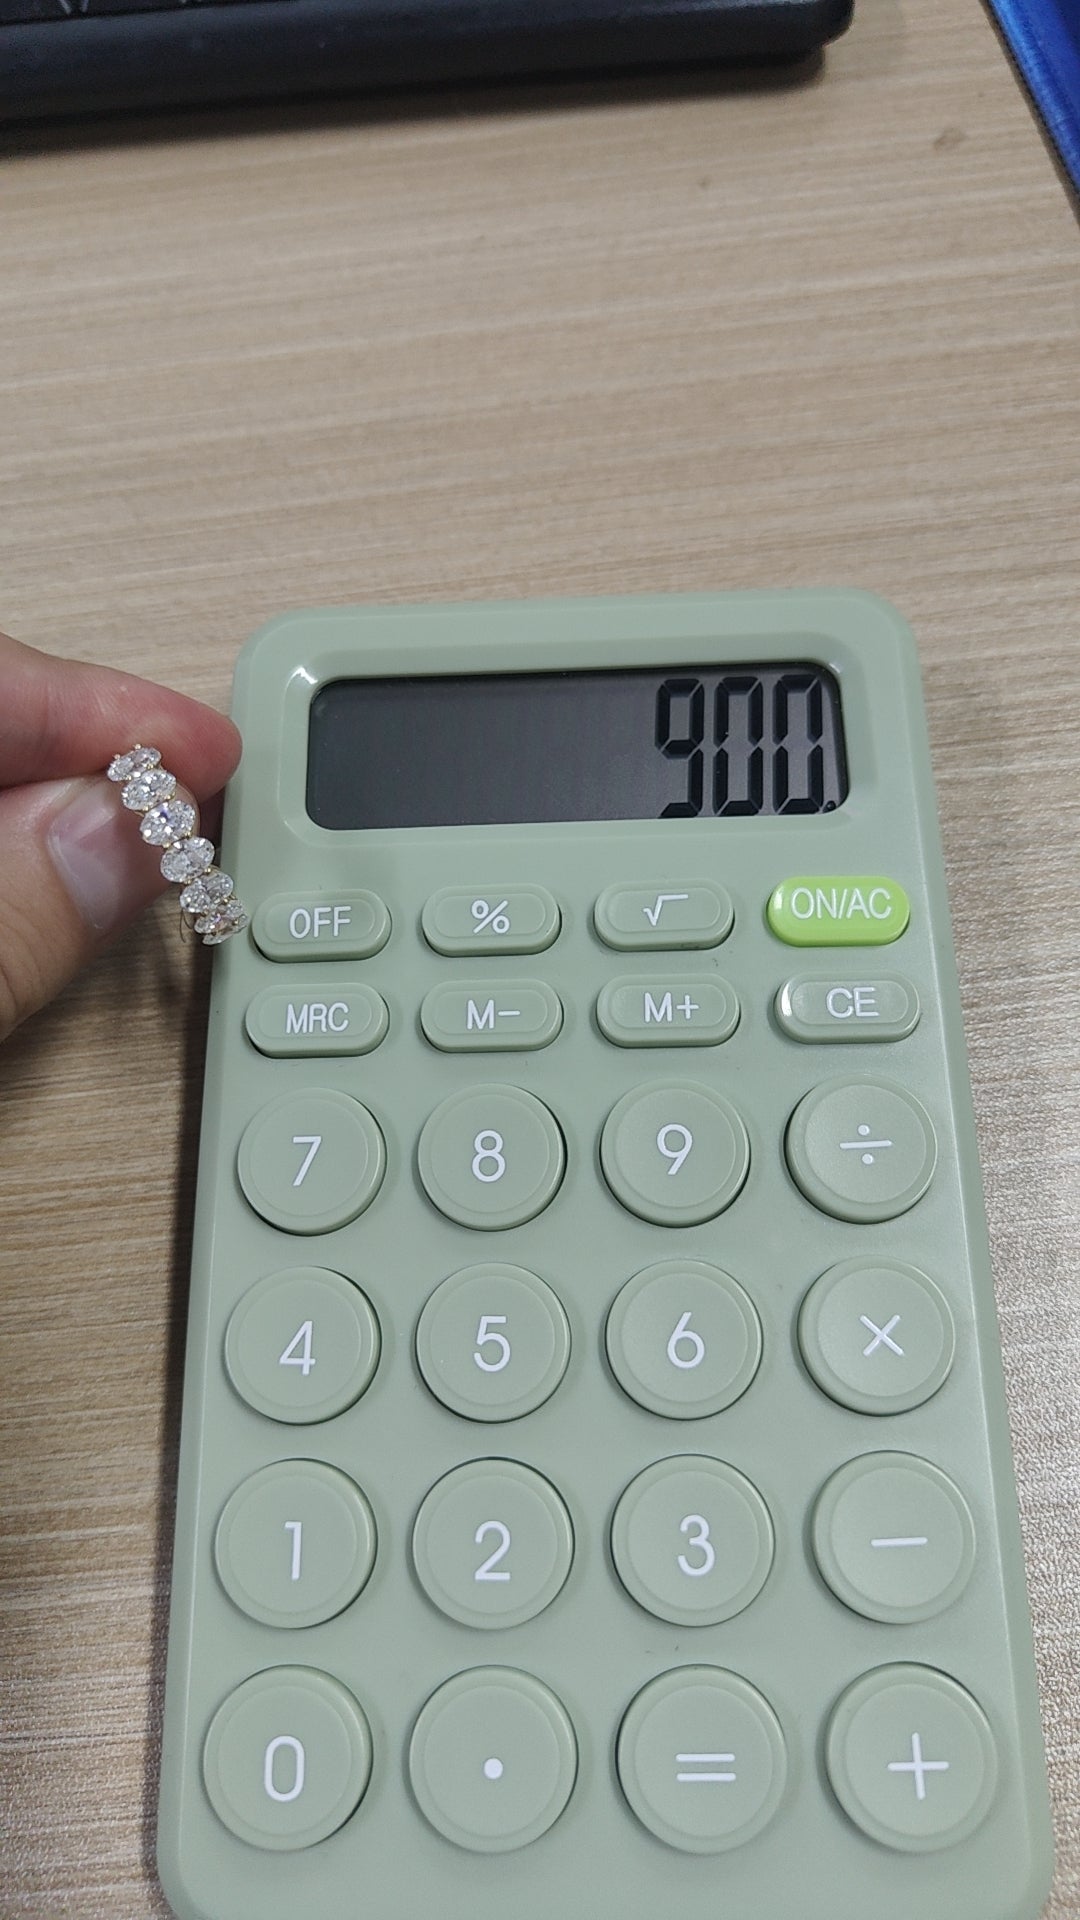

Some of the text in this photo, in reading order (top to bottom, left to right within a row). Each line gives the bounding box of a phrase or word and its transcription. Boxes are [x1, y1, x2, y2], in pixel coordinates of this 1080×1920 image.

[289, 906, 351, 939] OFF
[471, 899, 510, 934] %
[790, 887, 892, 919] ON/AC
[286, 1002, 349, 1034] MRC
[644, 992, 699, 1023] M+
[826, 986, 880, 1018] CE
[292, 1135, 322, 1186] 7
[471, 1130, 506, 1182] 8
[656, 1124, 693, 1175] 9
[279, 1320, 316, 1376] 4
[473, 1315, 511, 1372] 5
[667, 1311, 705, 1369] 6
[284, 1521, 302, 1581] 1
[474, 1520, 511, 1581] 2
[677, 1514, 715, 1577] 3
[264, 1735, 305, 1802] 0
